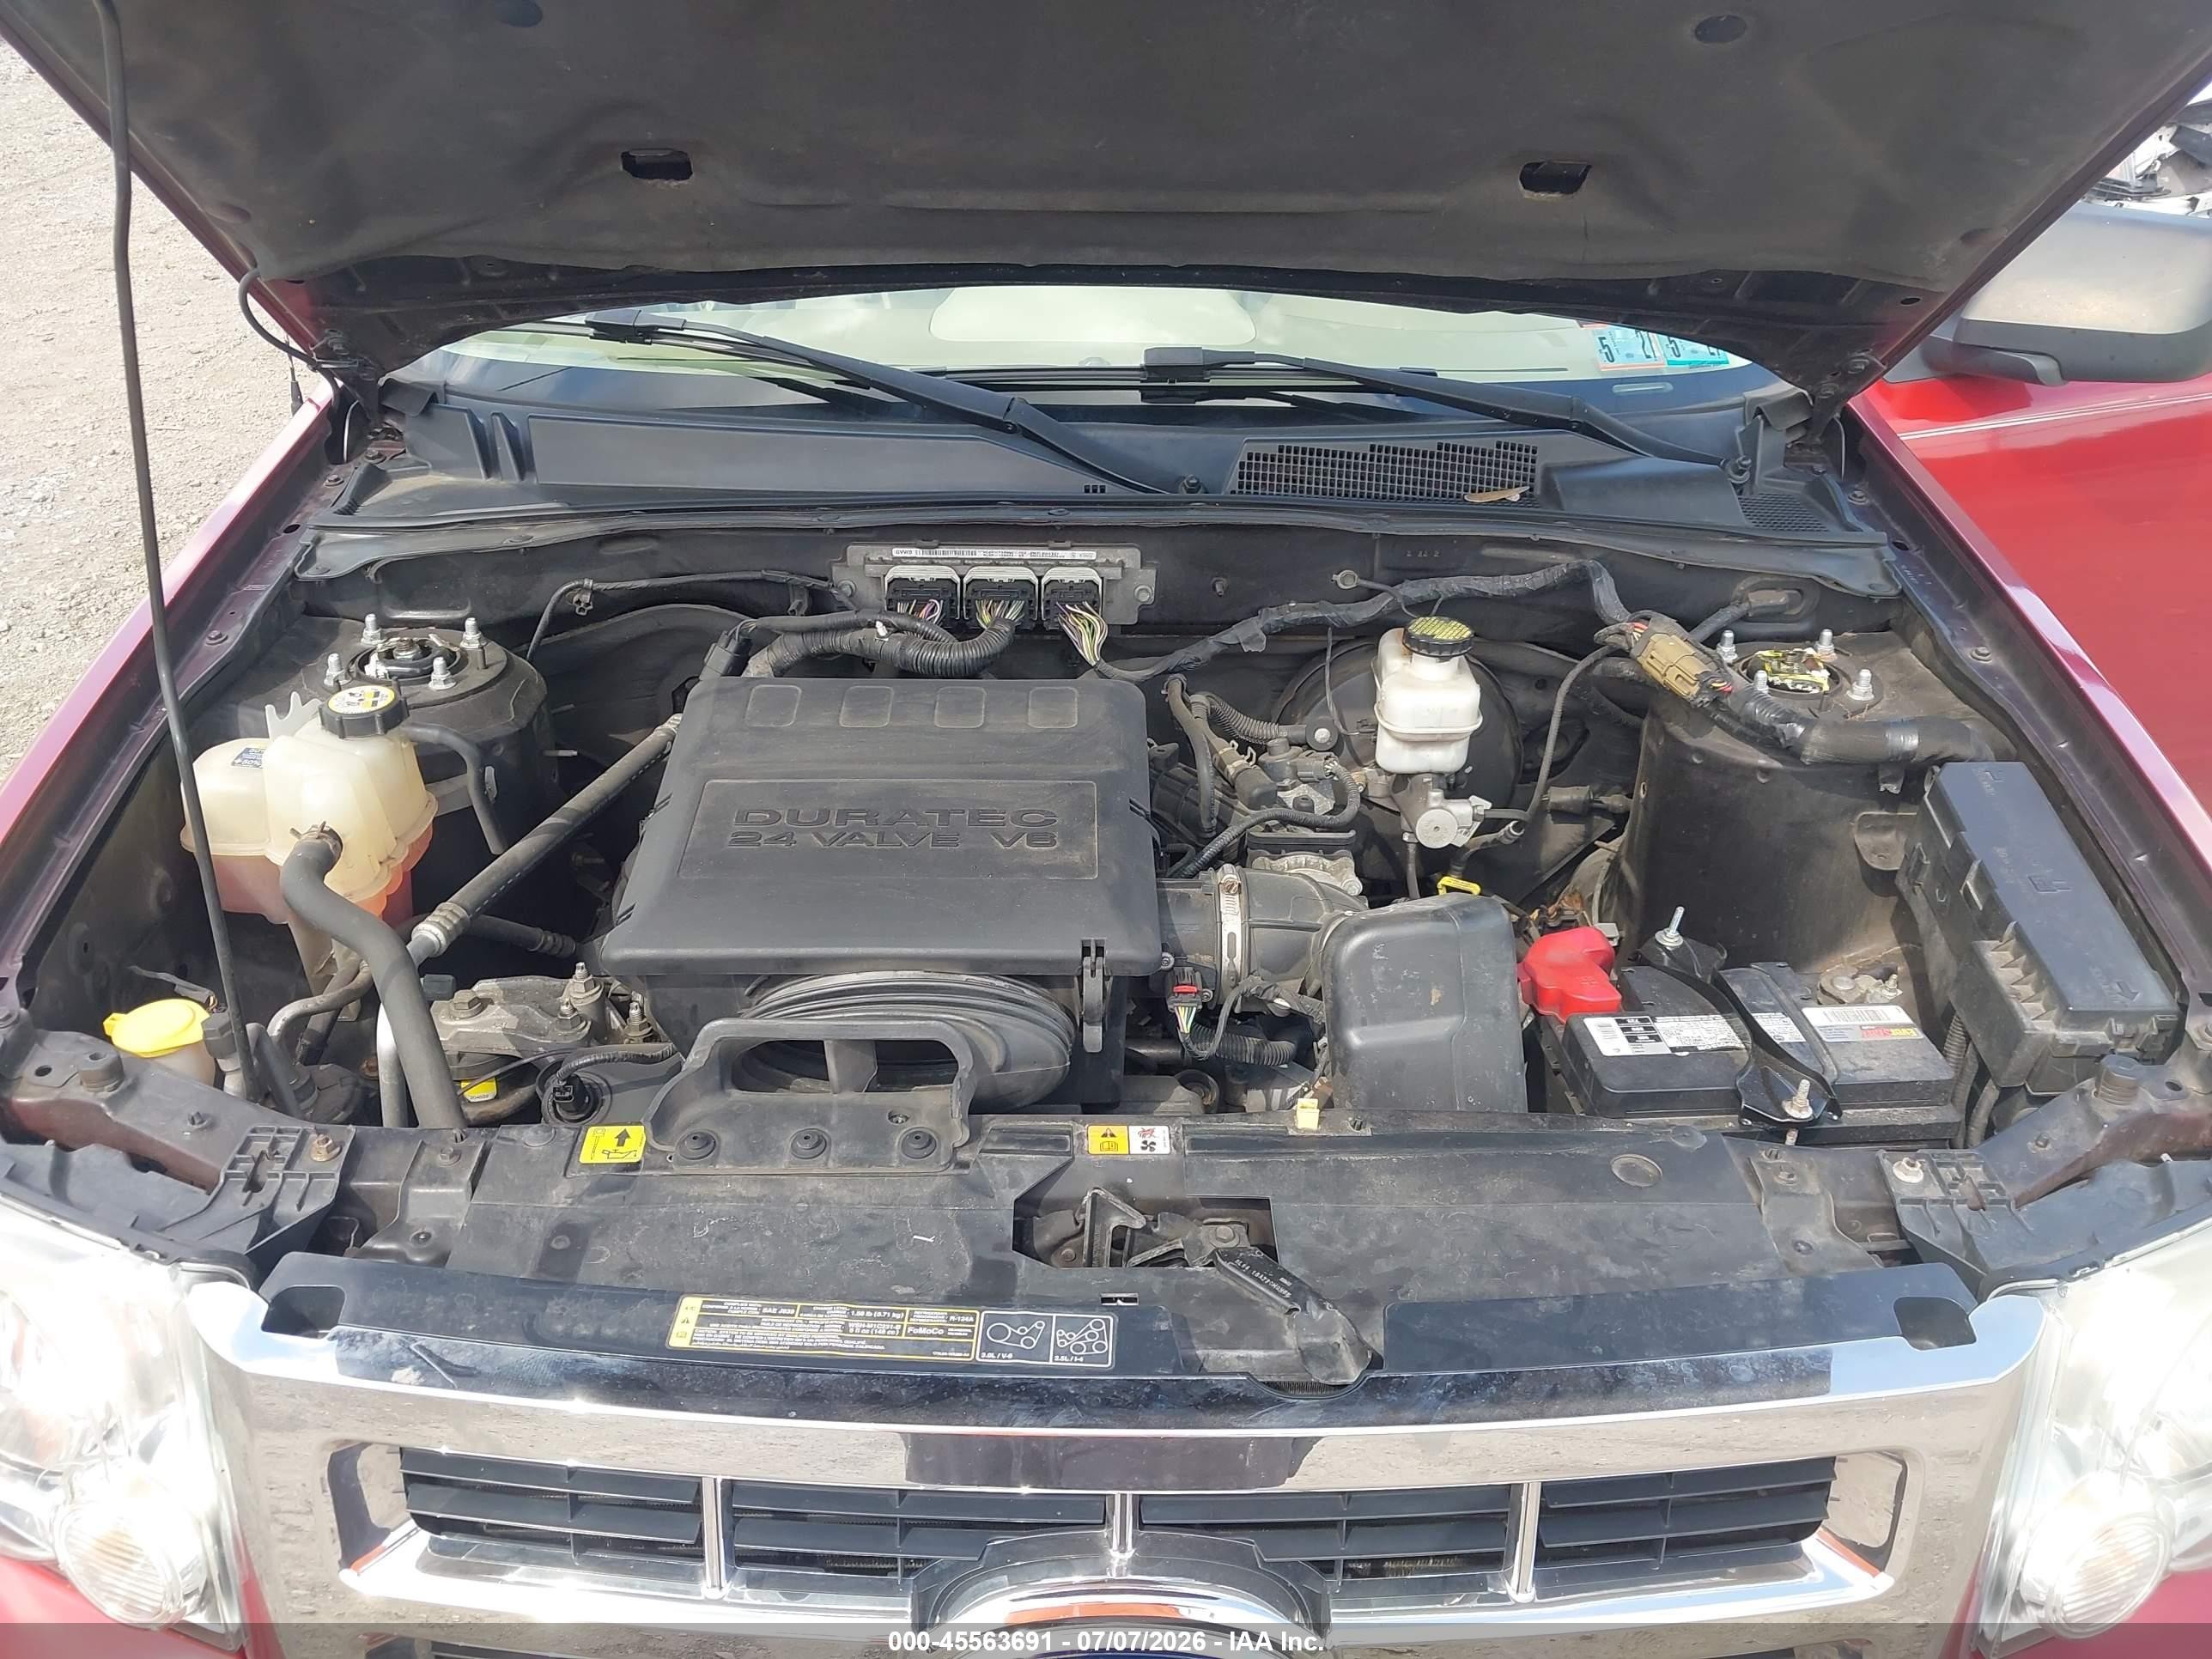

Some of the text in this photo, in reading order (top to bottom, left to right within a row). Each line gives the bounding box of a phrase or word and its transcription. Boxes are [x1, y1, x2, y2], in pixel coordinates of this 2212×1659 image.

[1598, 336, 1615, 363] 5
[1668, 336, 1681, 358] 5
[732, 808, 1059, 828] DURATEC
[727, 830, 1058, 849] 24 VALVE V6
[907, 1327, 945, 1336] FoMoCo
